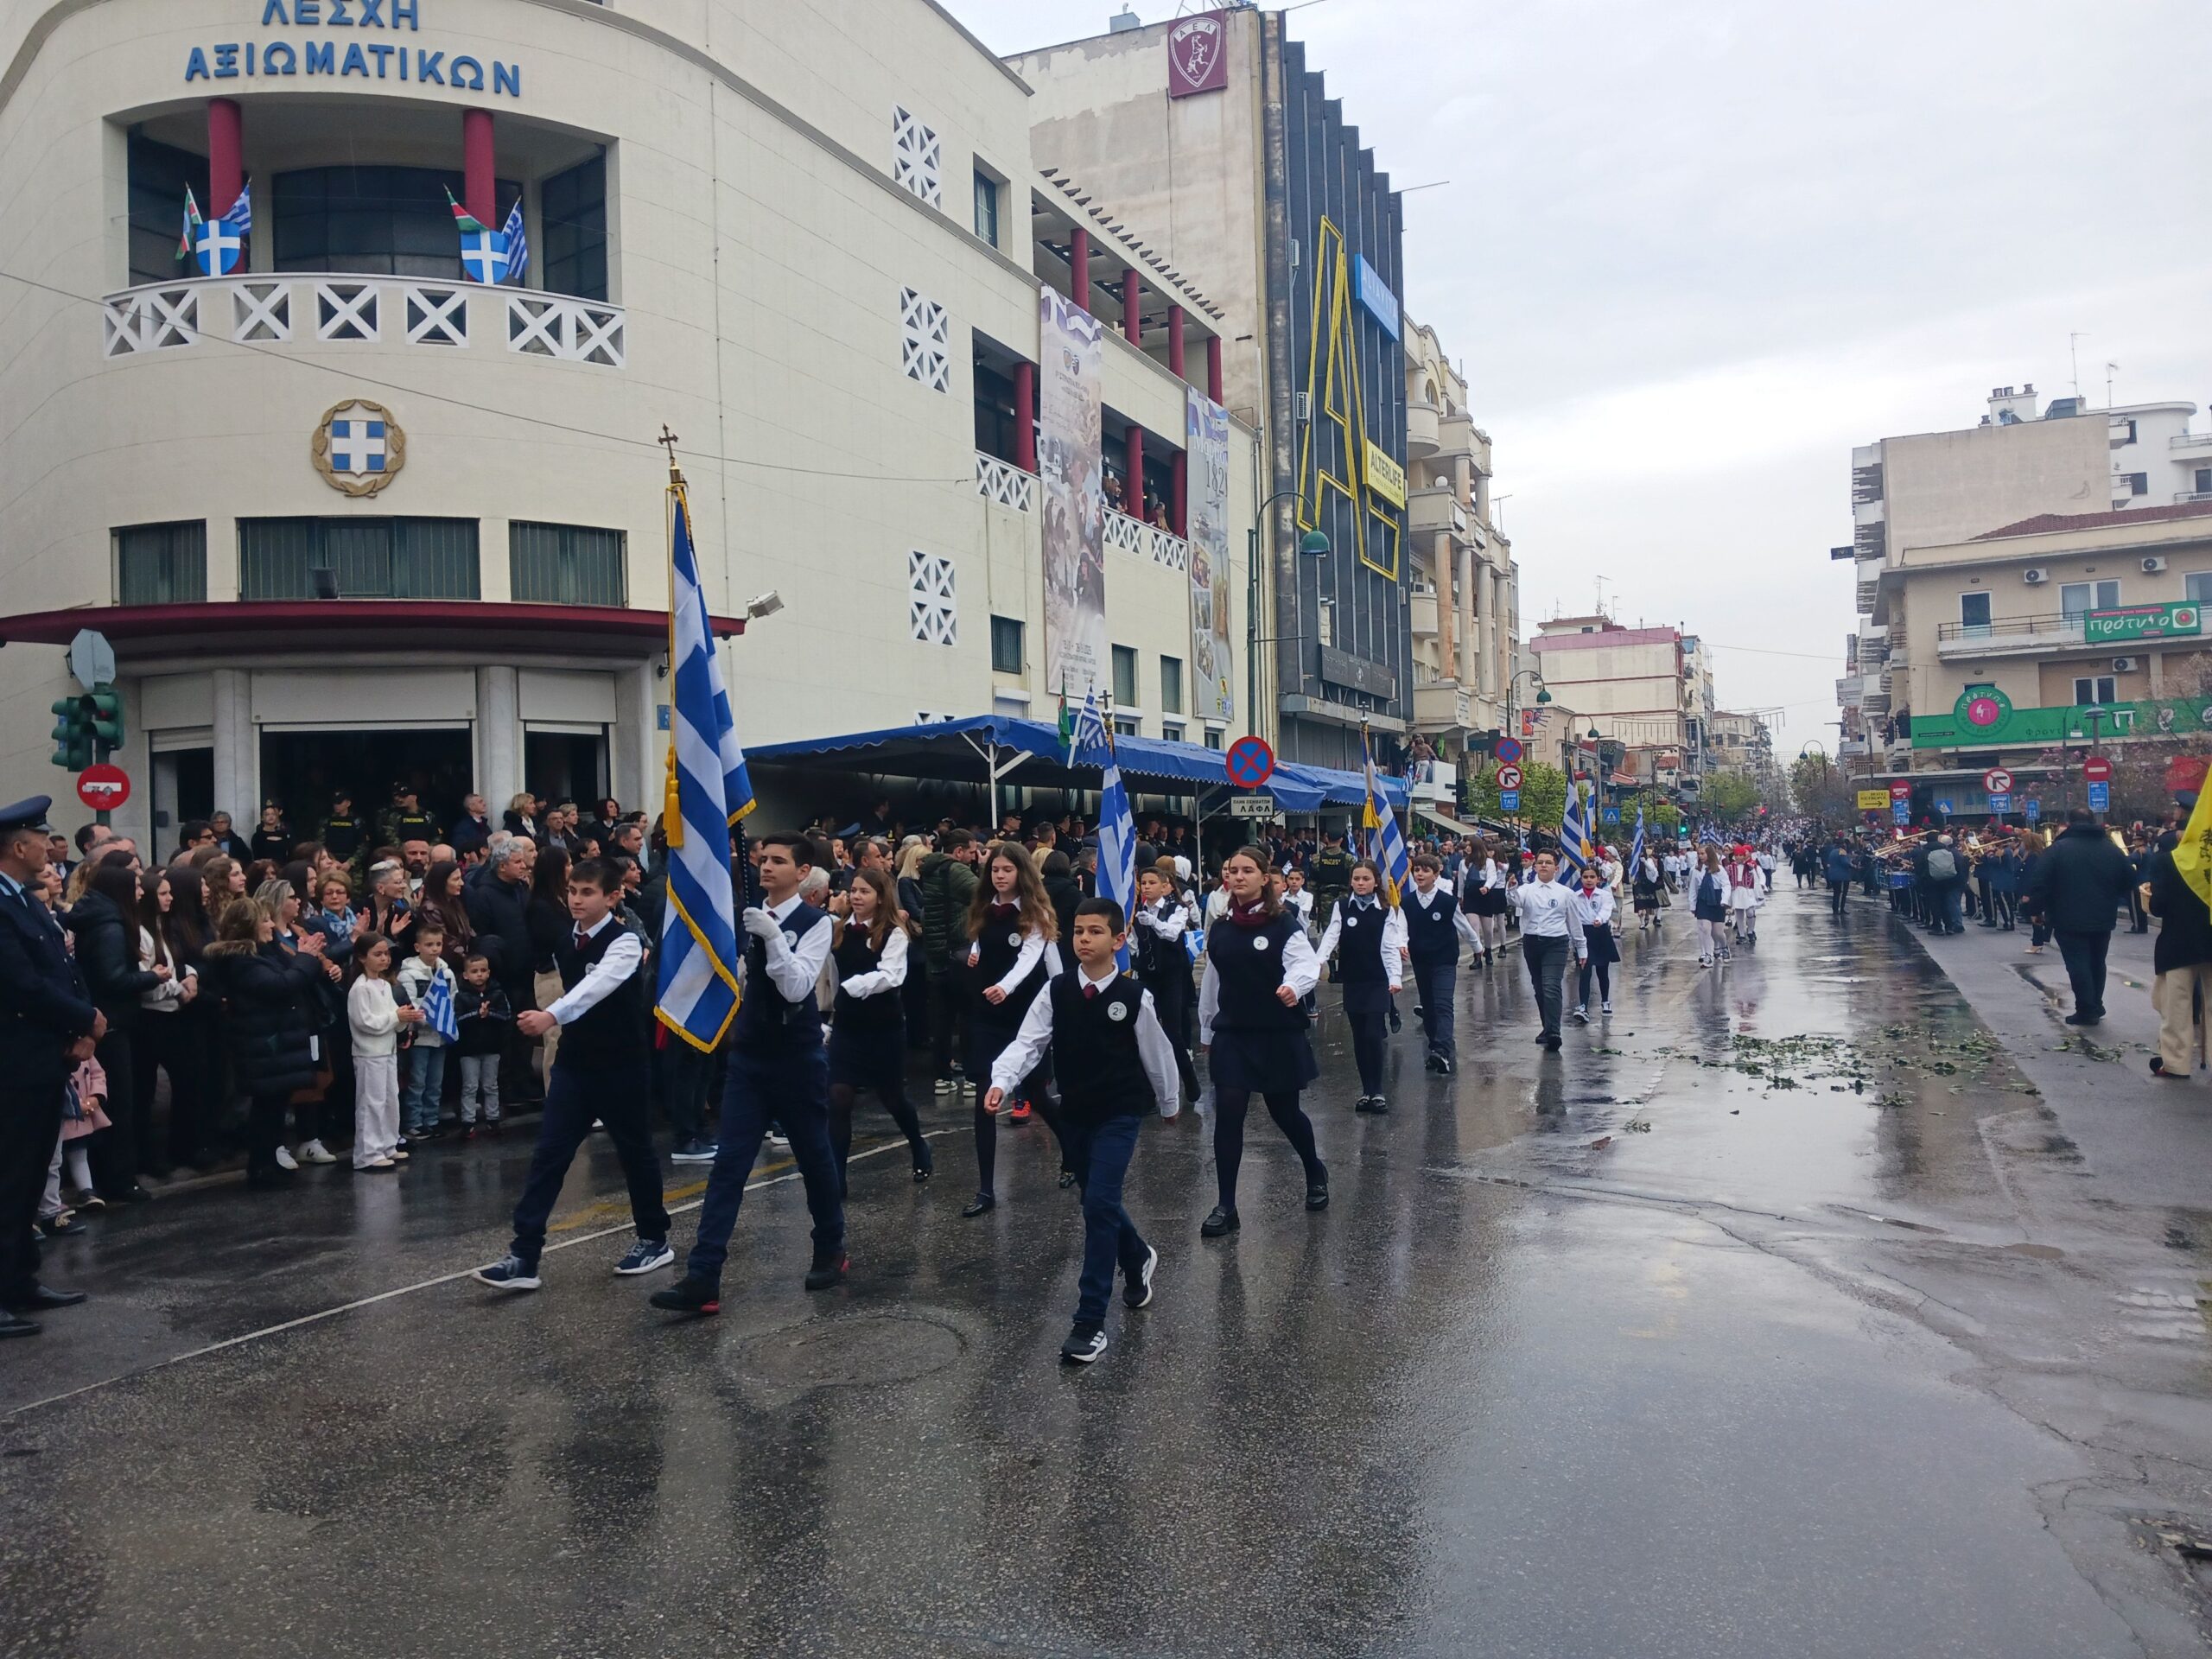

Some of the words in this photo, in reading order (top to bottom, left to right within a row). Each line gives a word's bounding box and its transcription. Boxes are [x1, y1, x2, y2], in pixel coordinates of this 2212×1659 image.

[262, 0, 419, 30] ΛΕΣΧΗ
[1180, 23, 1211, 37] ΑΕΛ
[184, 41, 520, 97] ΑΞΙΩΜΑΤΙΚΩΝ
[1370, 450, 1402, 491] ALTERLIFE
